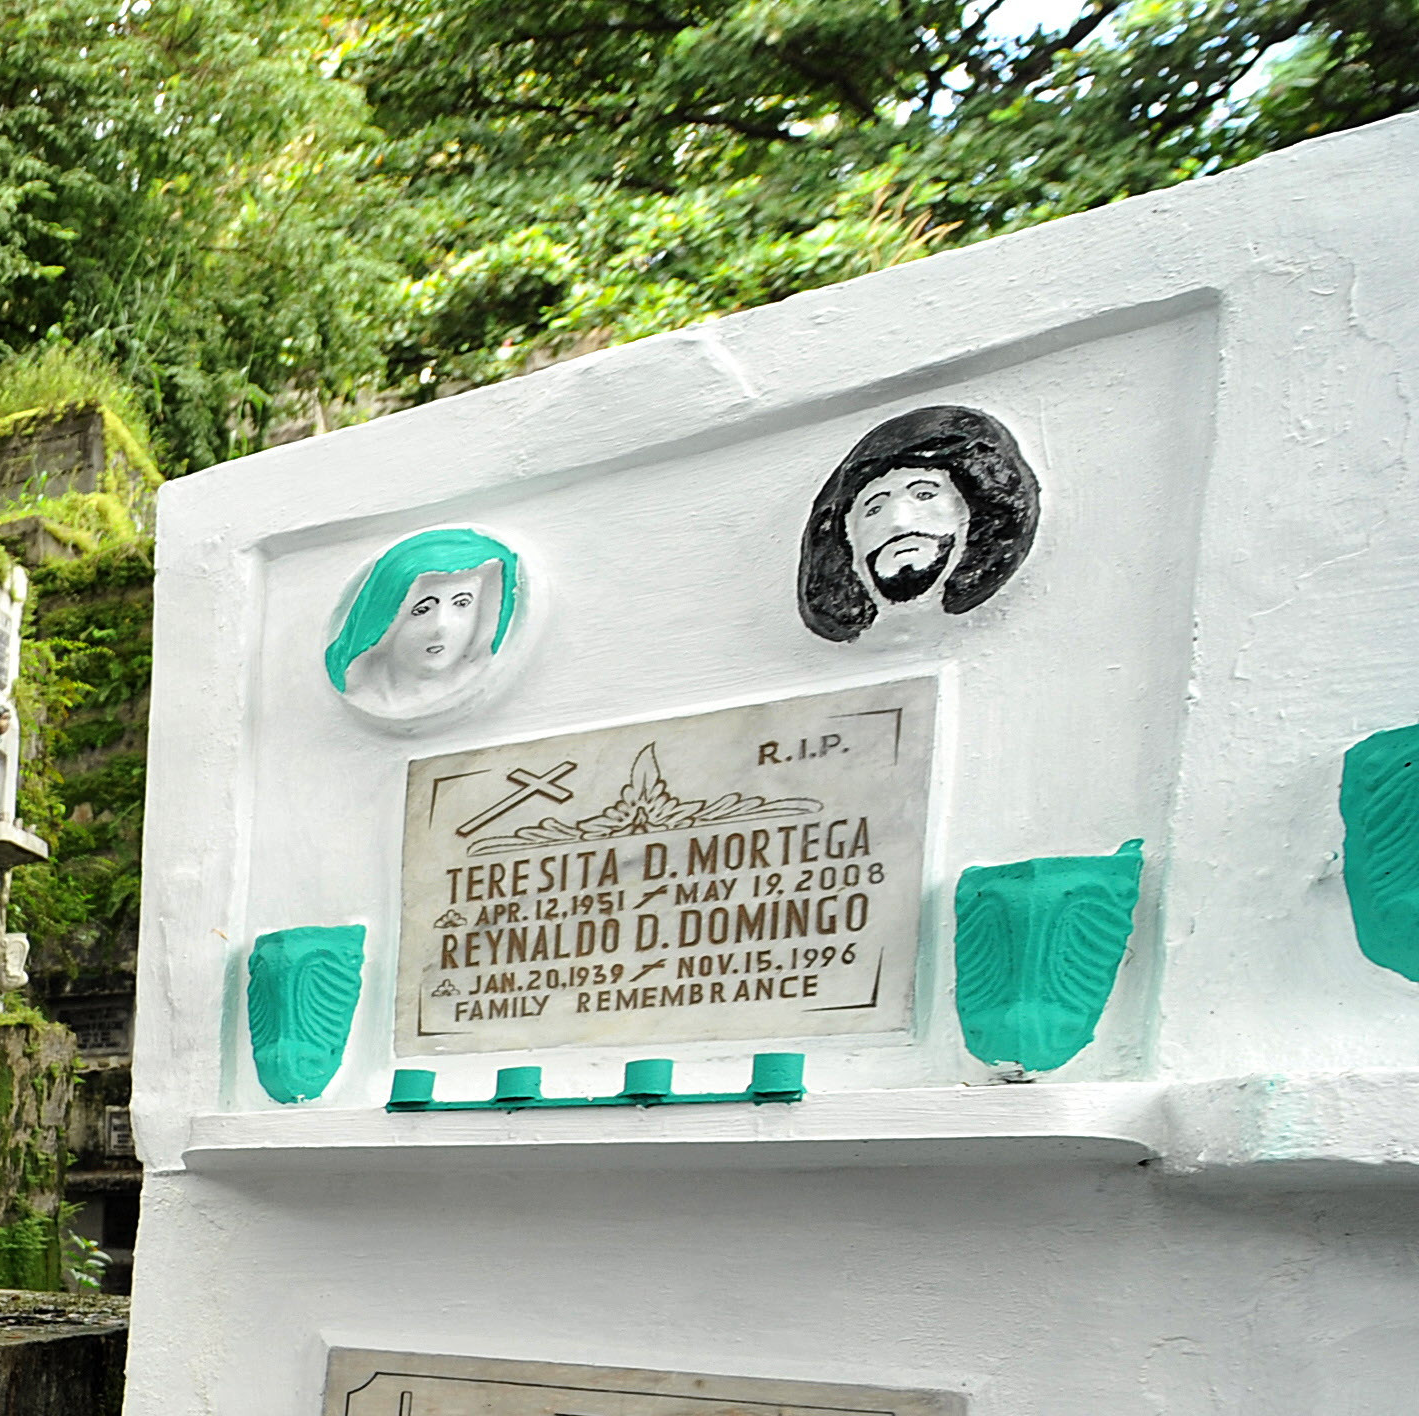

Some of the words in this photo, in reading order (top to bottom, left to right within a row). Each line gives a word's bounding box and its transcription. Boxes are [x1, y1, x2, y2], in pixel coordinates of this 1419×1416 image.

[758, 733, 850, 767] R.I.P.
[447, 847, 618, 904] TERESITA
[644, 842, 677, 882] D.
[688, 817, 871, 876] MORTEGA
[475, 903, 529, 927] APR.
[675, 878, 736, 905] MAY
[801, 862, 886, 893] 2008
[440, 917, 618, 969] REYNALDO
[635, 911, 669, 953] D.
[679, 893, 870, 946] DOMINGO
[454, 996, 548, 1022] FAMILY
[576, 976, 819, 1014] REMEMBRANCE
